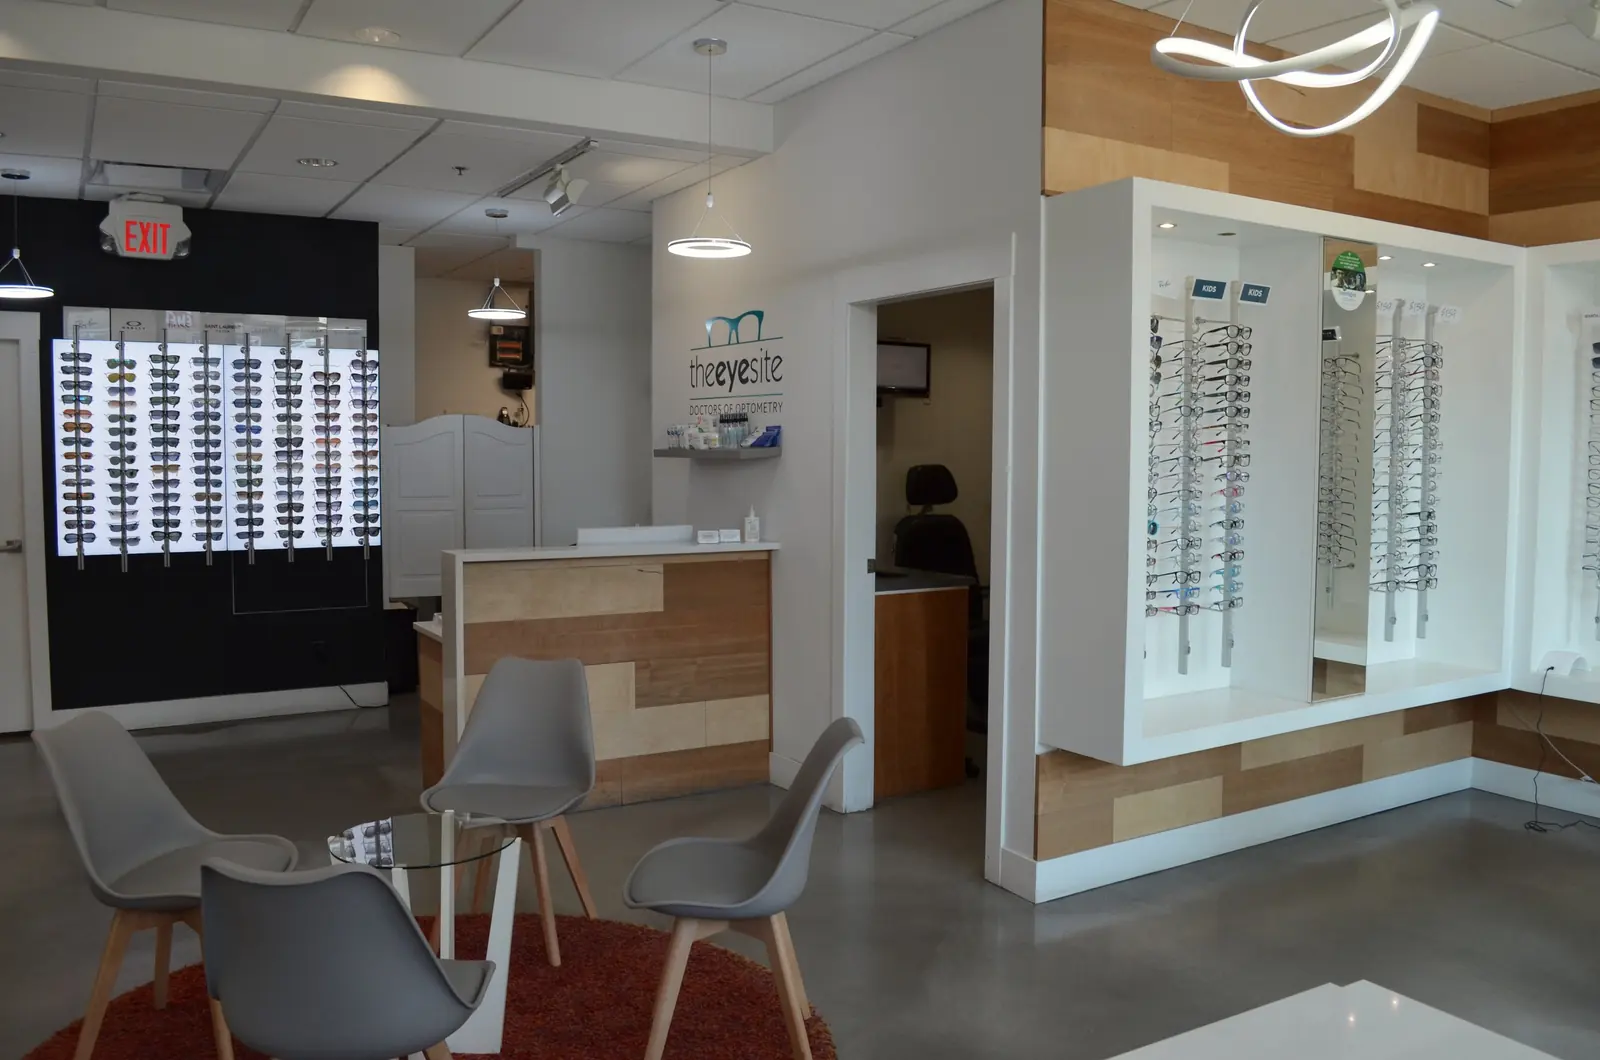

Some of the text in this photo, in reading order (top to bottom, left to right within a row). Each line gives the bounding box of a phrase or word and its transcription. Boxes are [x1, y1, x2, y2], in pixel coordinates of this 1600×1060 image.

[125, 220, 171, 254] EXIT
[1202, 284, 1217, 293] KIDS
[1248, 288, 1263, 297] KIDS
[689, 401, 783, 416] DOCTORS OF OPTOMETRY
